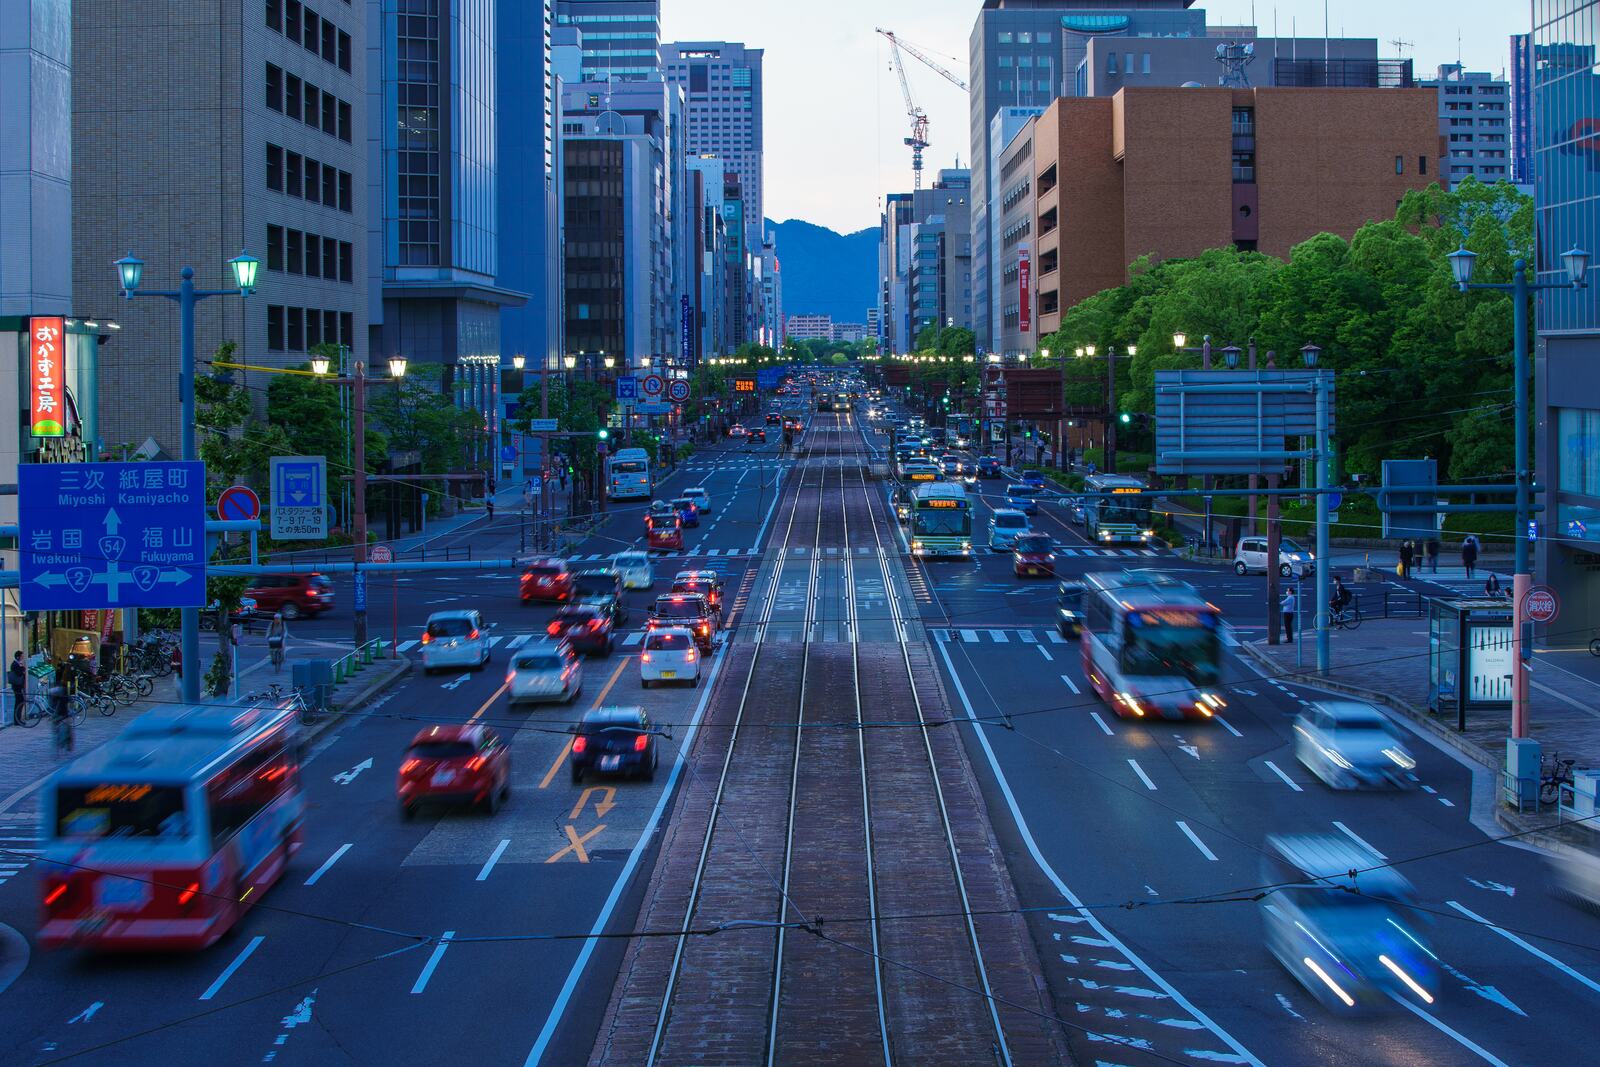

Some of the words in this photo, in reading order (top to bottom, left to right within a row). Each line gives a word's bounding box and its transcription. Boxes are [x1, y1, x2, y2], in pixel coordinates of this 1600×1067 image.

[36, 326, 58, 413] おかず工房
[673, 385, 687, 396] 50
[59, 469, 105, 490] 三次
[119, 468, 189, 489] 紙屋町
[58, 493, 106, 507] Miyoshi
[118, 492, 189, 506] Kamiyacho
[31, 529, 82, 550] 岩国
[142, 526, 193, 548] 福山
[104, 540, 121, 553] 54
[32, 553, 81, 565] Iwakuni
[141, 551, 194, 564] Fukuyama
[75, 571, 84, 586] 2
[141, 569, 151, 584] 2
[1529, 600, 1553, 612] 消火栓
